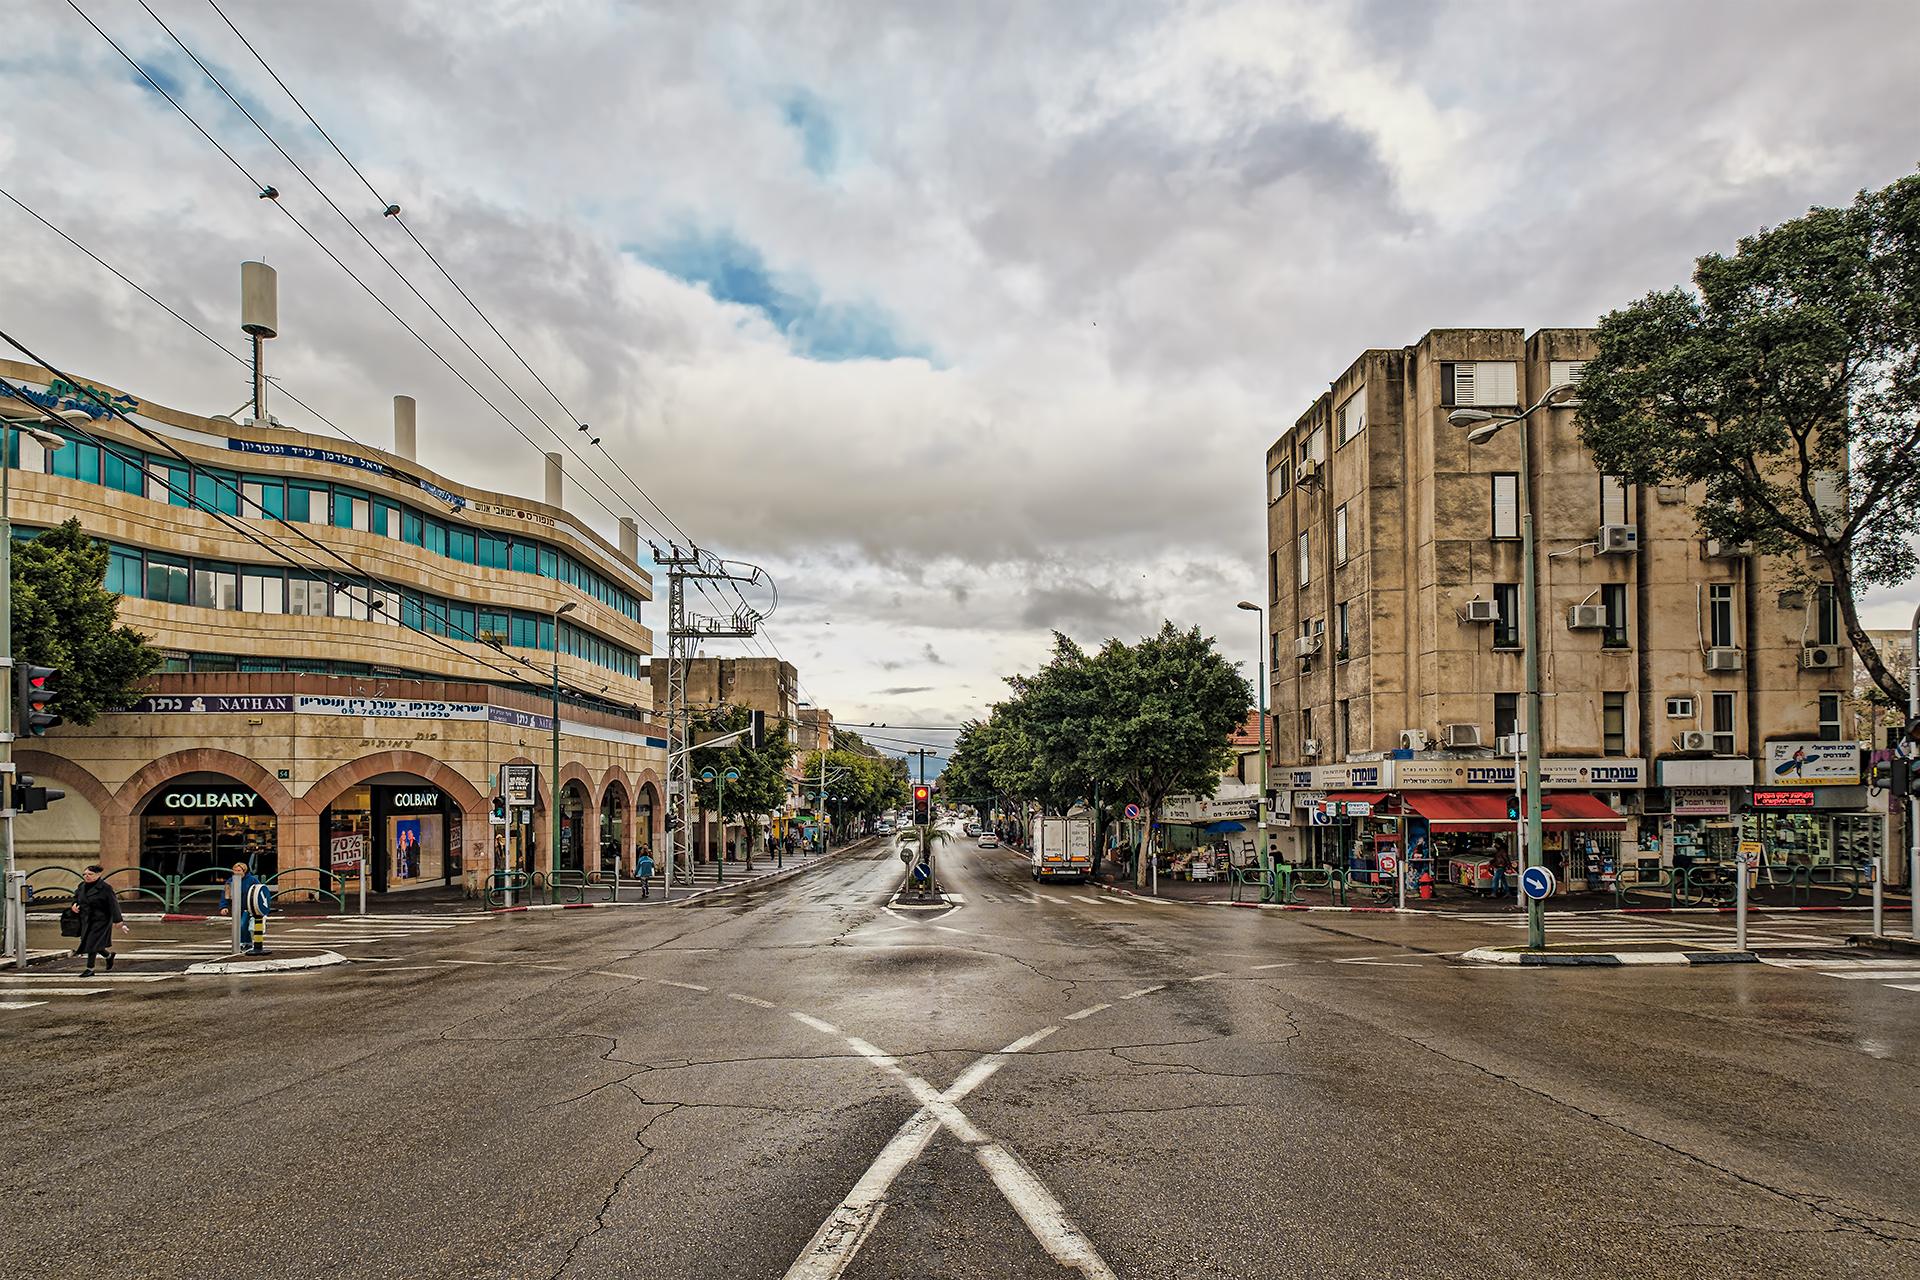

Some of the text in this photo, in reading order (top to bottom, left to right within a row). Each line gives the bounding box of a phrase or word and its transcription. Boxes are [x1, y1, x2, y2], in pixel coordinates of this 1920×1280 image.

[240, 441, 284, 454] ונוטריון
[321, 450, 354, 464] פלדמן
[149, 698, 183, 712] נתן
[219, 698, 287, 710] NATHAN
[300, 697, 345, 707] ונוטריון
[349, 699, 365, 708] דין
[370, 700, 396, 709] עורך
[409, 702, 446, 711] פלדמן
[449, 703, 483, 712] ישראל
[516, 713, 529, 725] נתן
[1352, 767, 1378, 781] שומרה
[1467, 767, 1516, 779] שומרה
[1591, 767, 1638, 779] שומרה
[165, 793, 258, 808] GOLBARY
[394, 792, 438, 807] GOLBARY
[332, 836, 361, 851] 70%
[333, 849, 361, 862] הנחה
